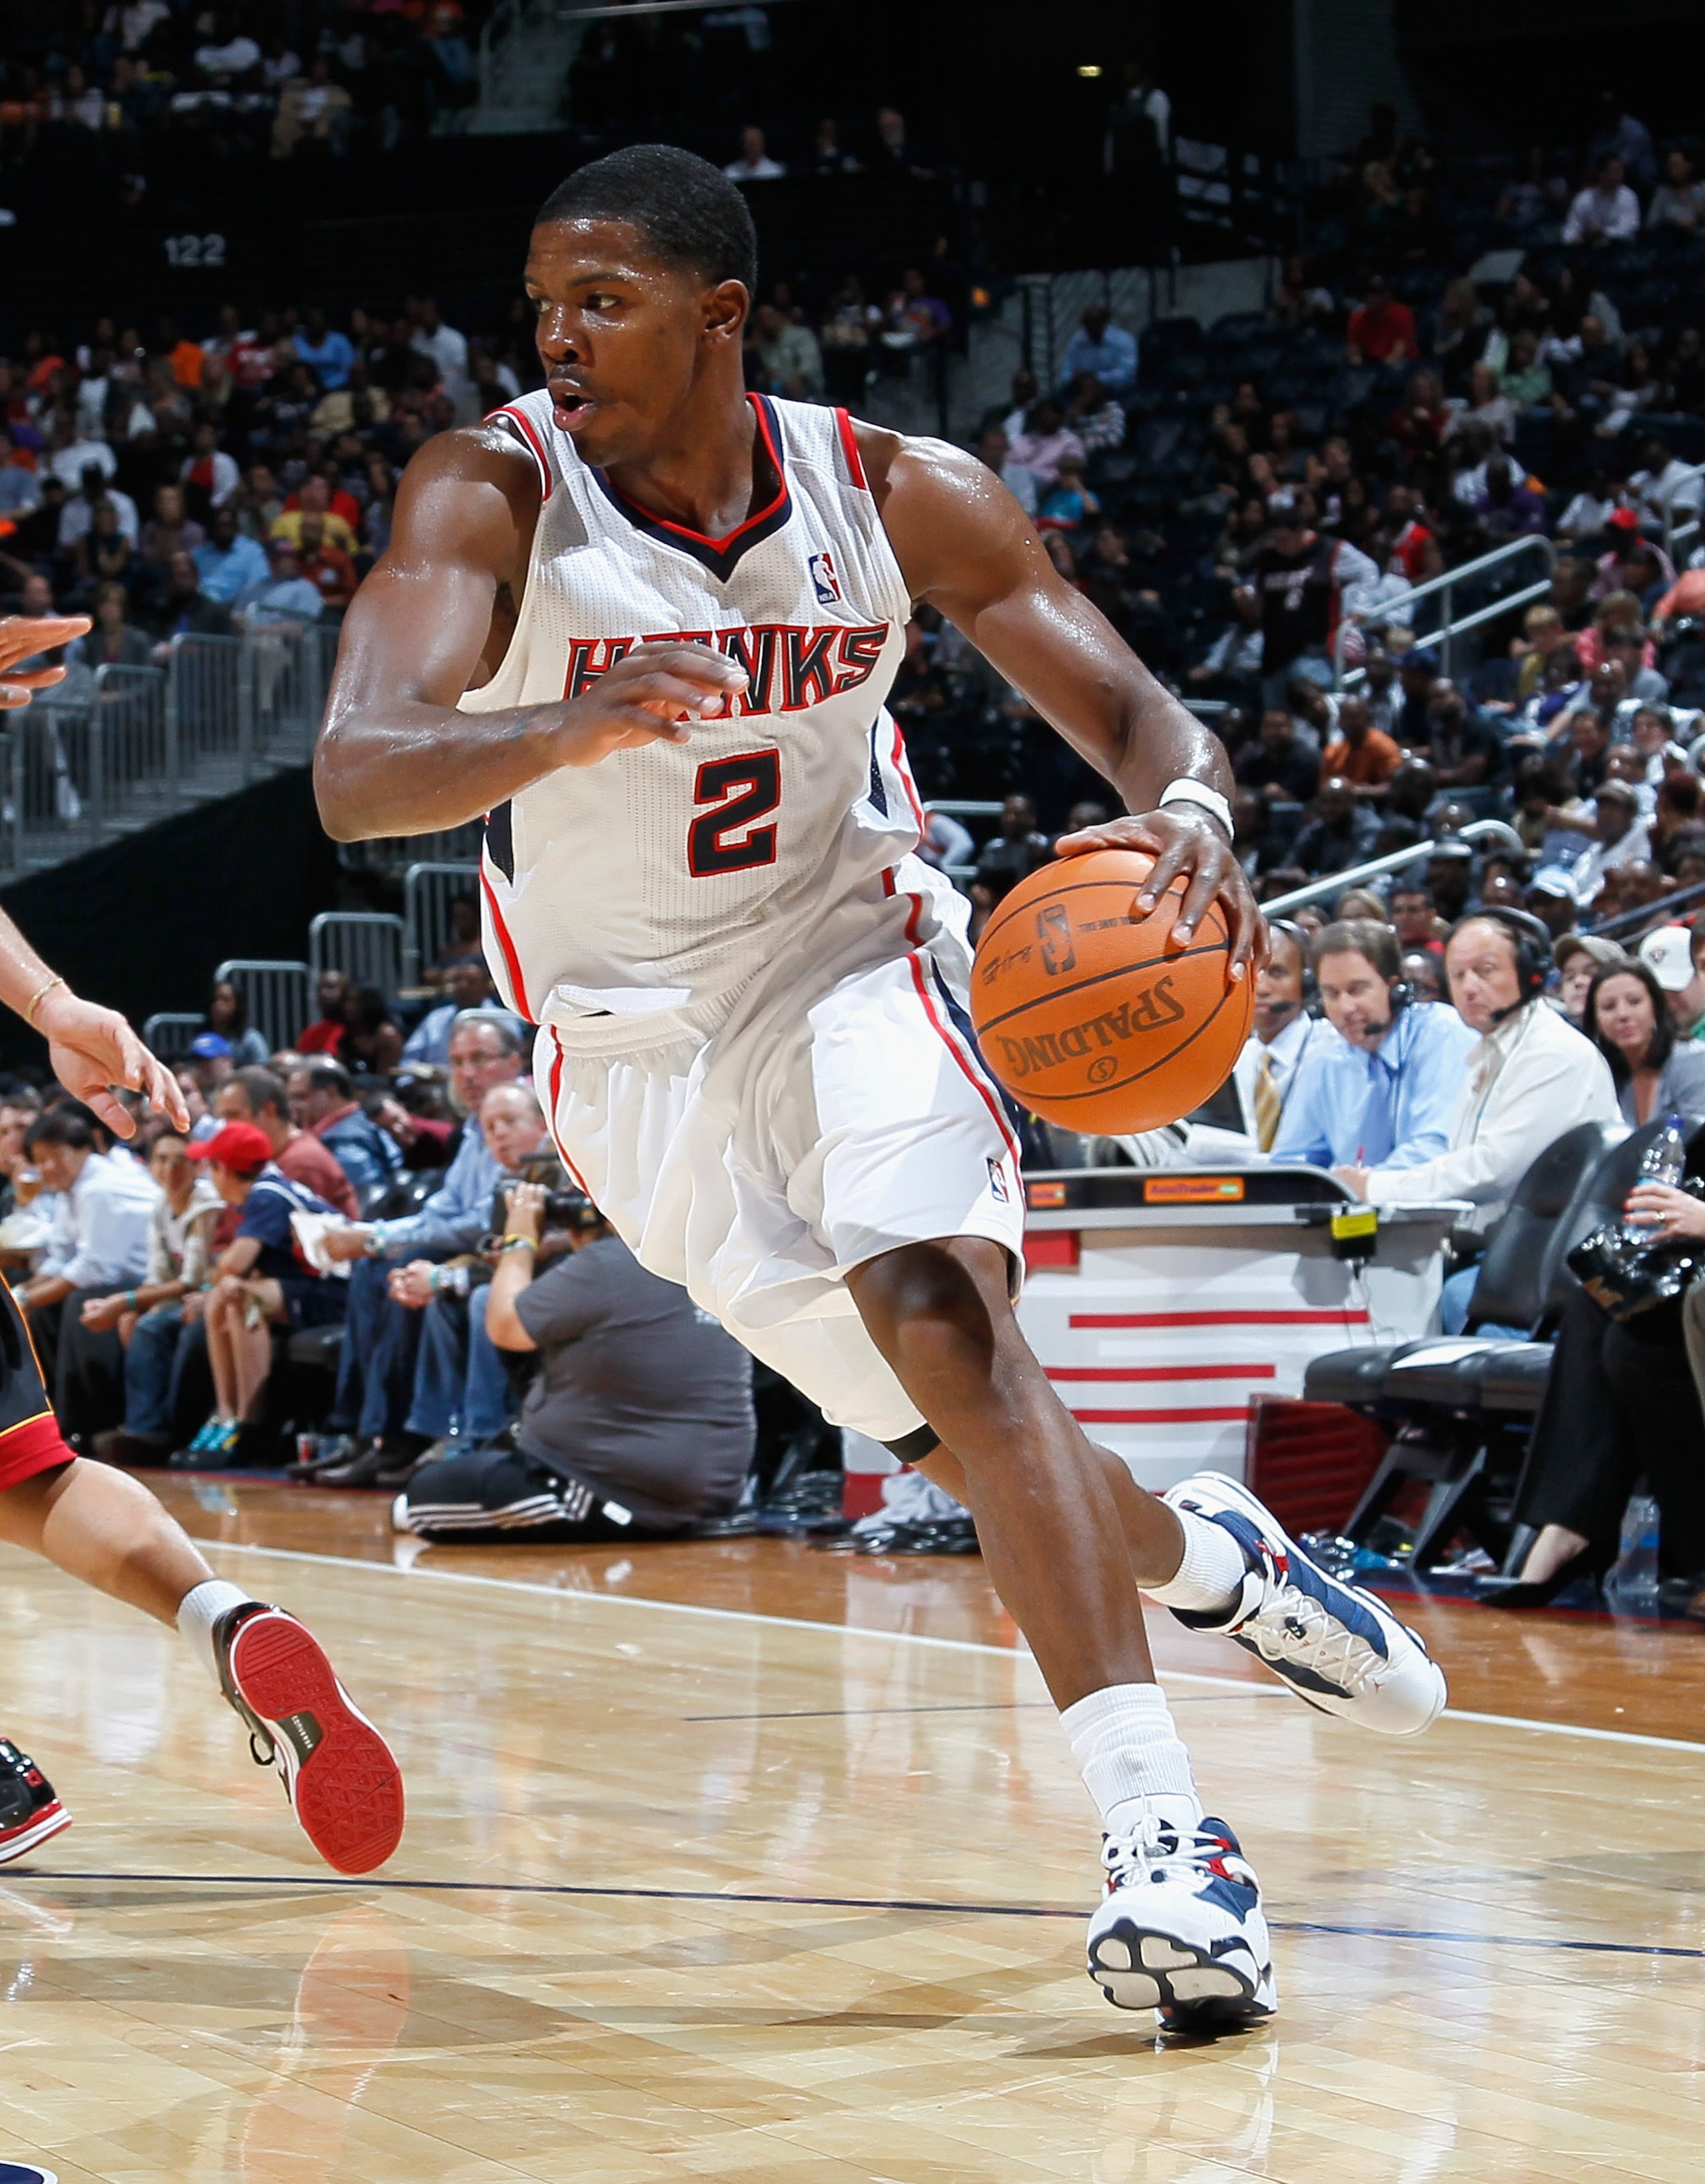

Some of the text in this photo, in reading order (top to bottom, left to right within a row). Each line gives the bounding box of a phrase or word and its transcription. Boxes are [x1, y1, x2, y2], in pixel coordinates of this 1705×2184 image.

[165, 234, 225, 265] 122
[563, 623, 888, 721] HWKS
[687, 749, 780, 878] 2
[996, 975, 1186, 1077] SPALDING
